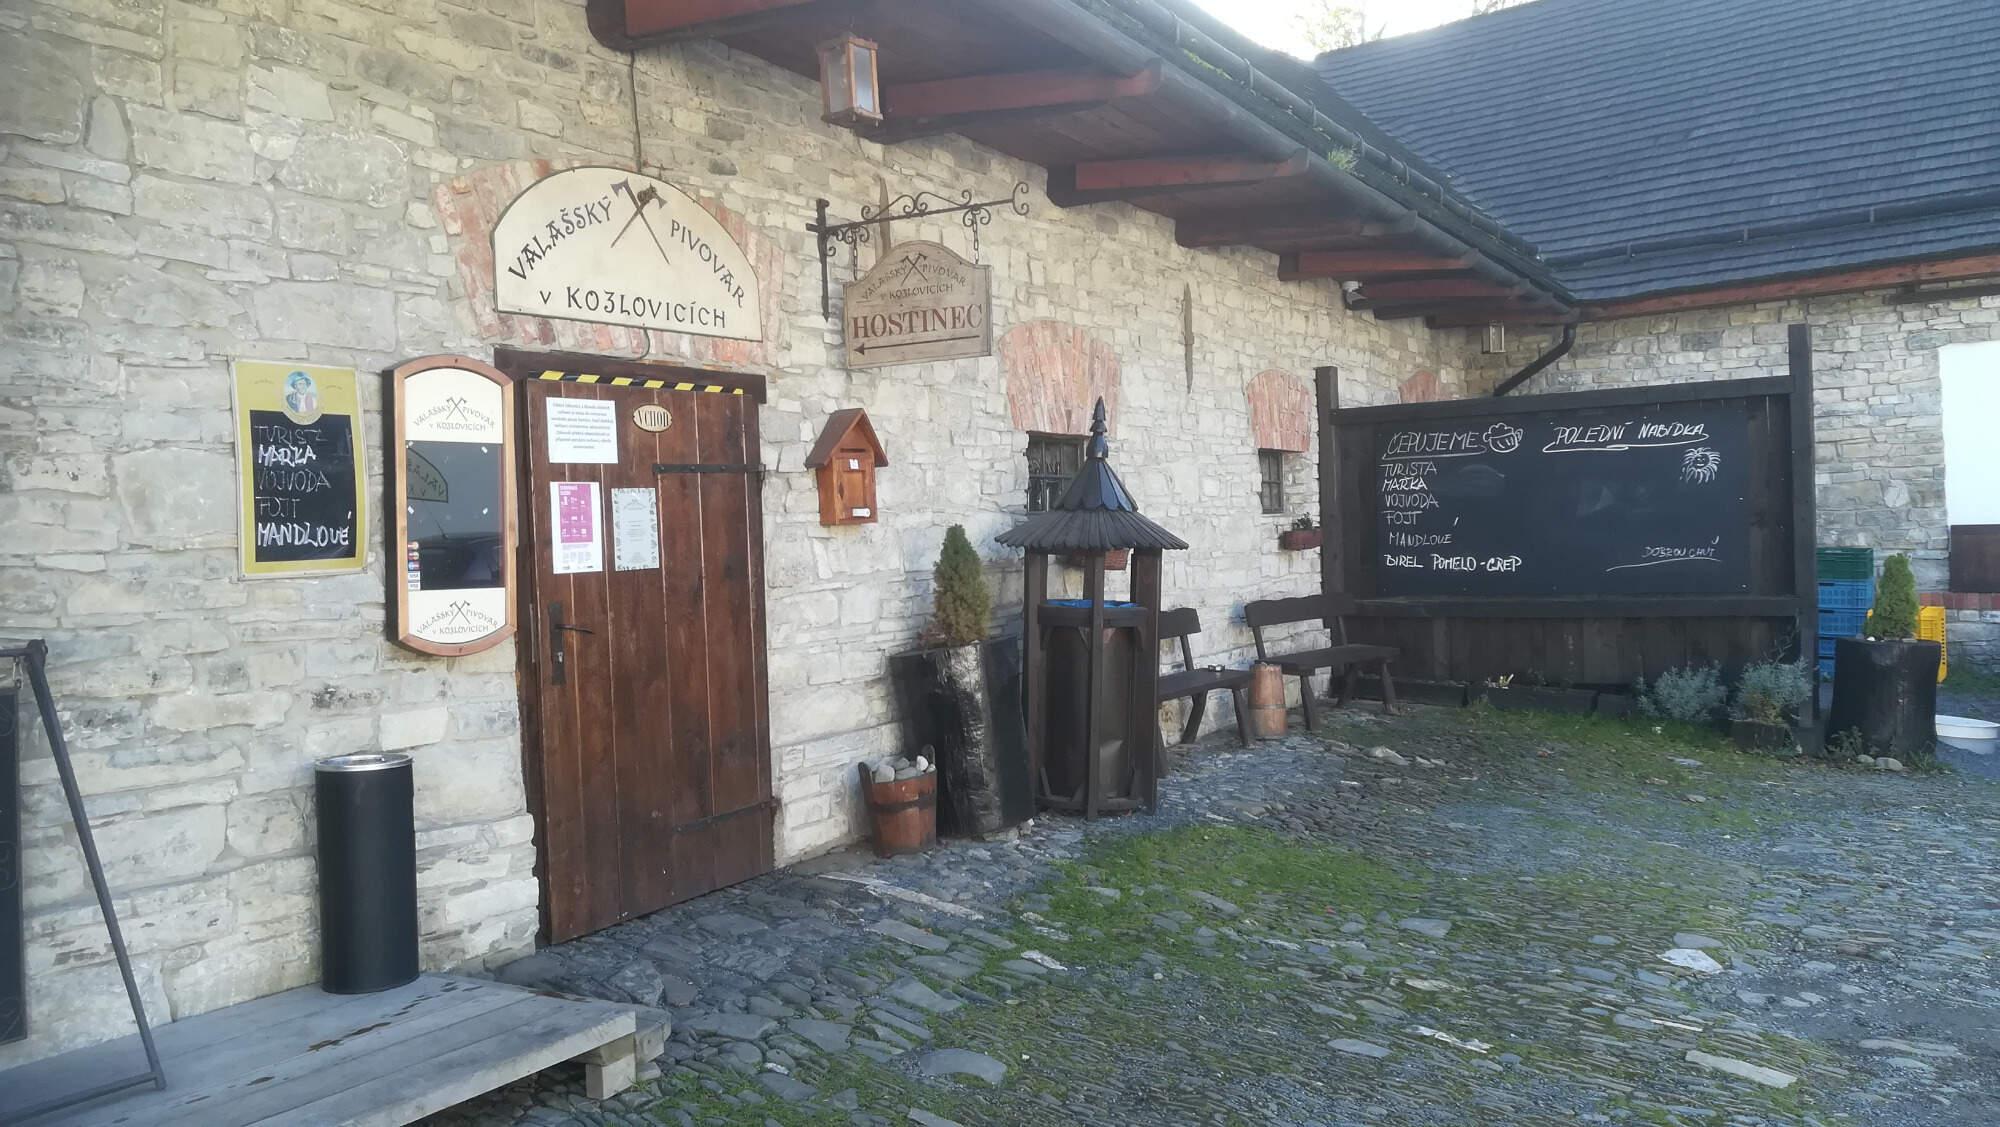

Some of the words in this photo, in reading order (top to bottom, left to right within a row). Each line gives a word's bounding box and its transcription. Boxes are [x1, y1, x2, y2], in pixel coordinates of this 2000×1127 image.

[670, 219, 745, 308] PIVOVAR
[852, 304, 983, 340] HOSTINEC
[1380, 460, 1437, 477] TURISTA
[1384, 493, 1439, 509] VOJVODA
[1383, 510, 1423, 525] FOJT
